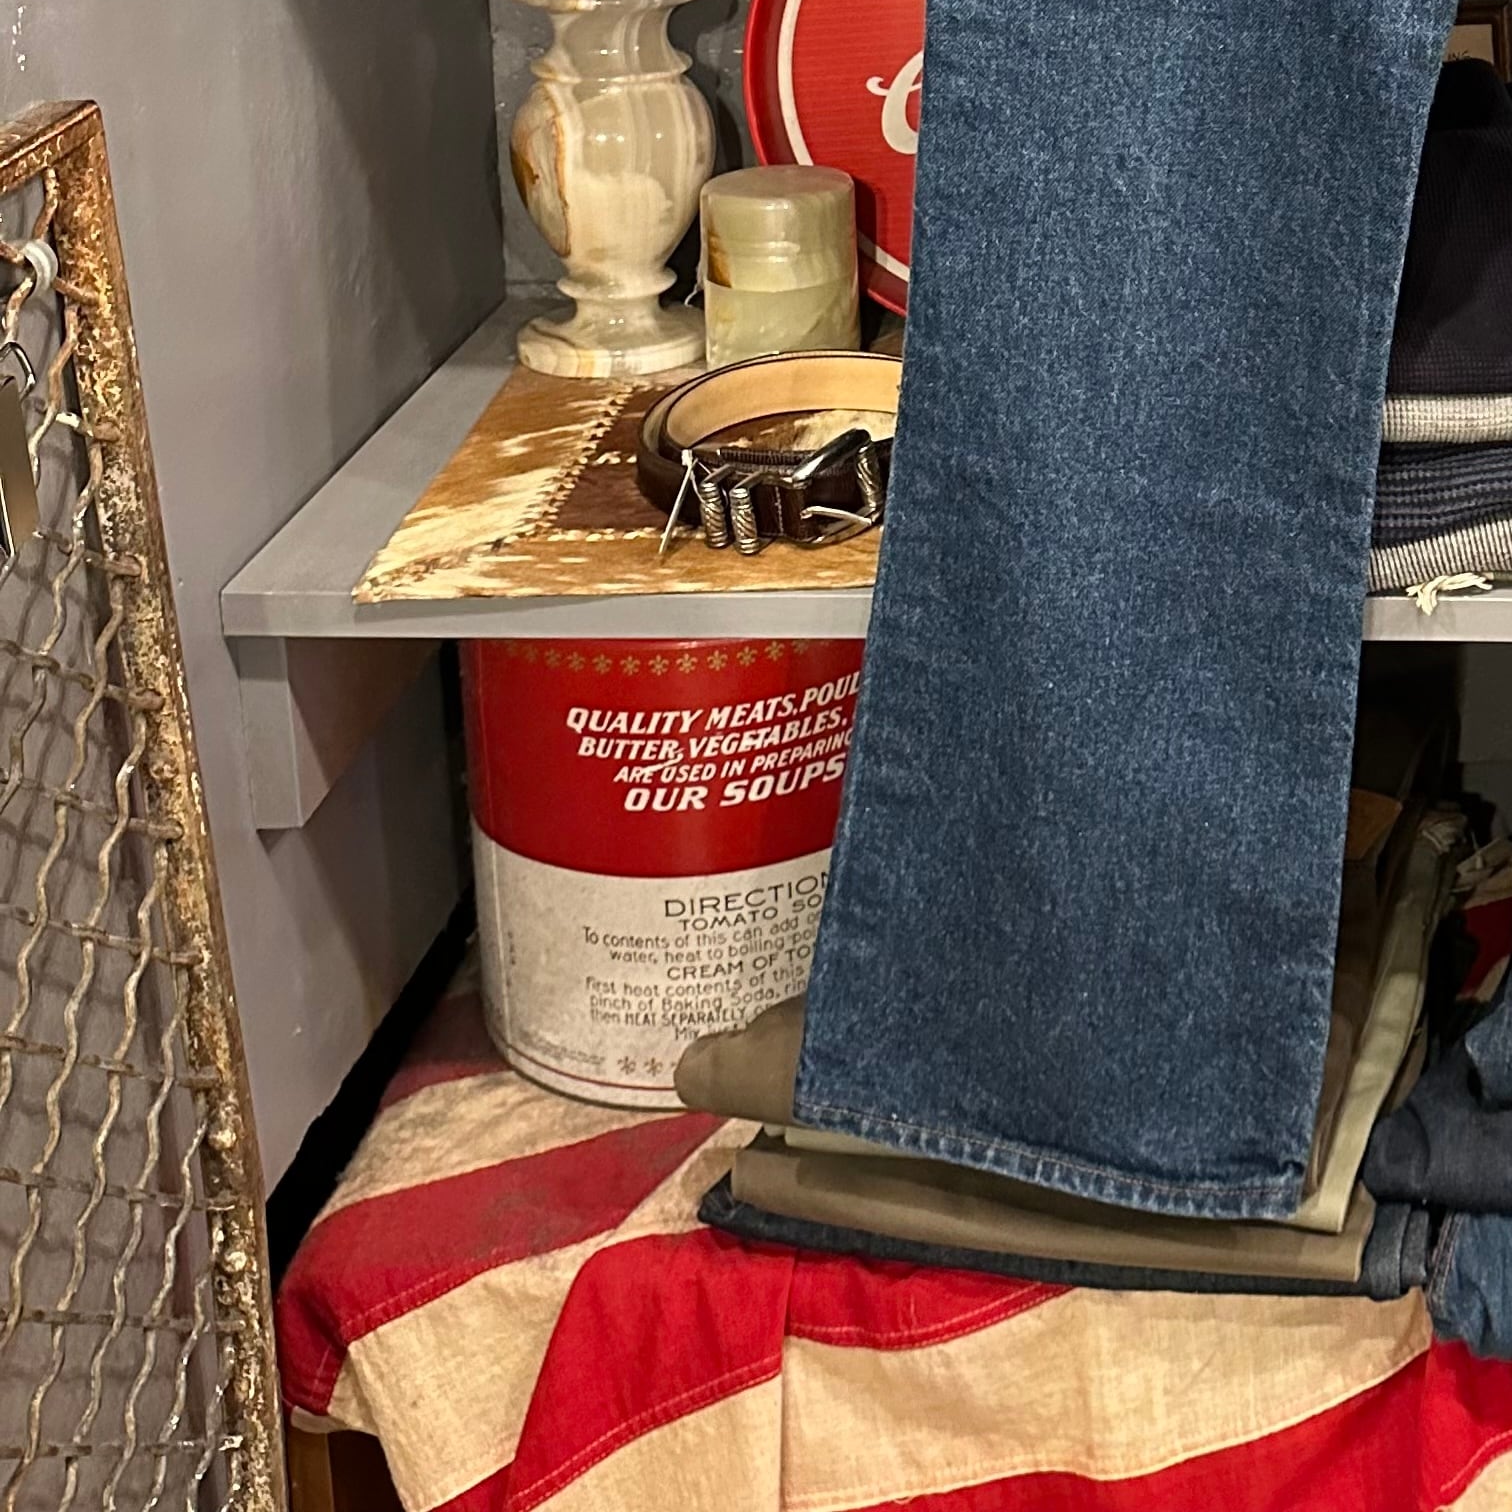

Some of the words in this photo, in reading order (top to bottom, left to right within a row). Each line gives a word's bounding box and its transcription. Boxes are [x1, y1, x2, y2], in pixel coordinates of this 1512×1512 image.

[565, 706, 703, 735] QUALITY
[612, 765, 655, 785] ARE
[660, 762, 717, 784] USED
[720, 758, 746, 779] IN
[623, 786, 709, 813] OUR
[719, 752, 847, 808] SOUPS
[582, 925, 599, 945] To
[602, 933, 670, 950] contents
[674, 934, 690, 949] of
[696, 930, 728, 947] this
[732, 926, 763, 944] can
[769, 915, 799, 936] add
[679, 907, 778, 932] TOMATO
[609, 949, 659, 965] water,
[664, 949, 702, 963] heat
[707, 946, 724, 961] to
[666, 960, 744, 982] CREAM
[752, 952, 778, 970] OF
[784, 944, 815, 963] TO
[665, 978, 743, 997] contents
[749, 972, 766, 988] of
[772, 964, 805, 985] this
[637, 997, 655, 1011] of
[661, 994, 723, 1013] Baking
